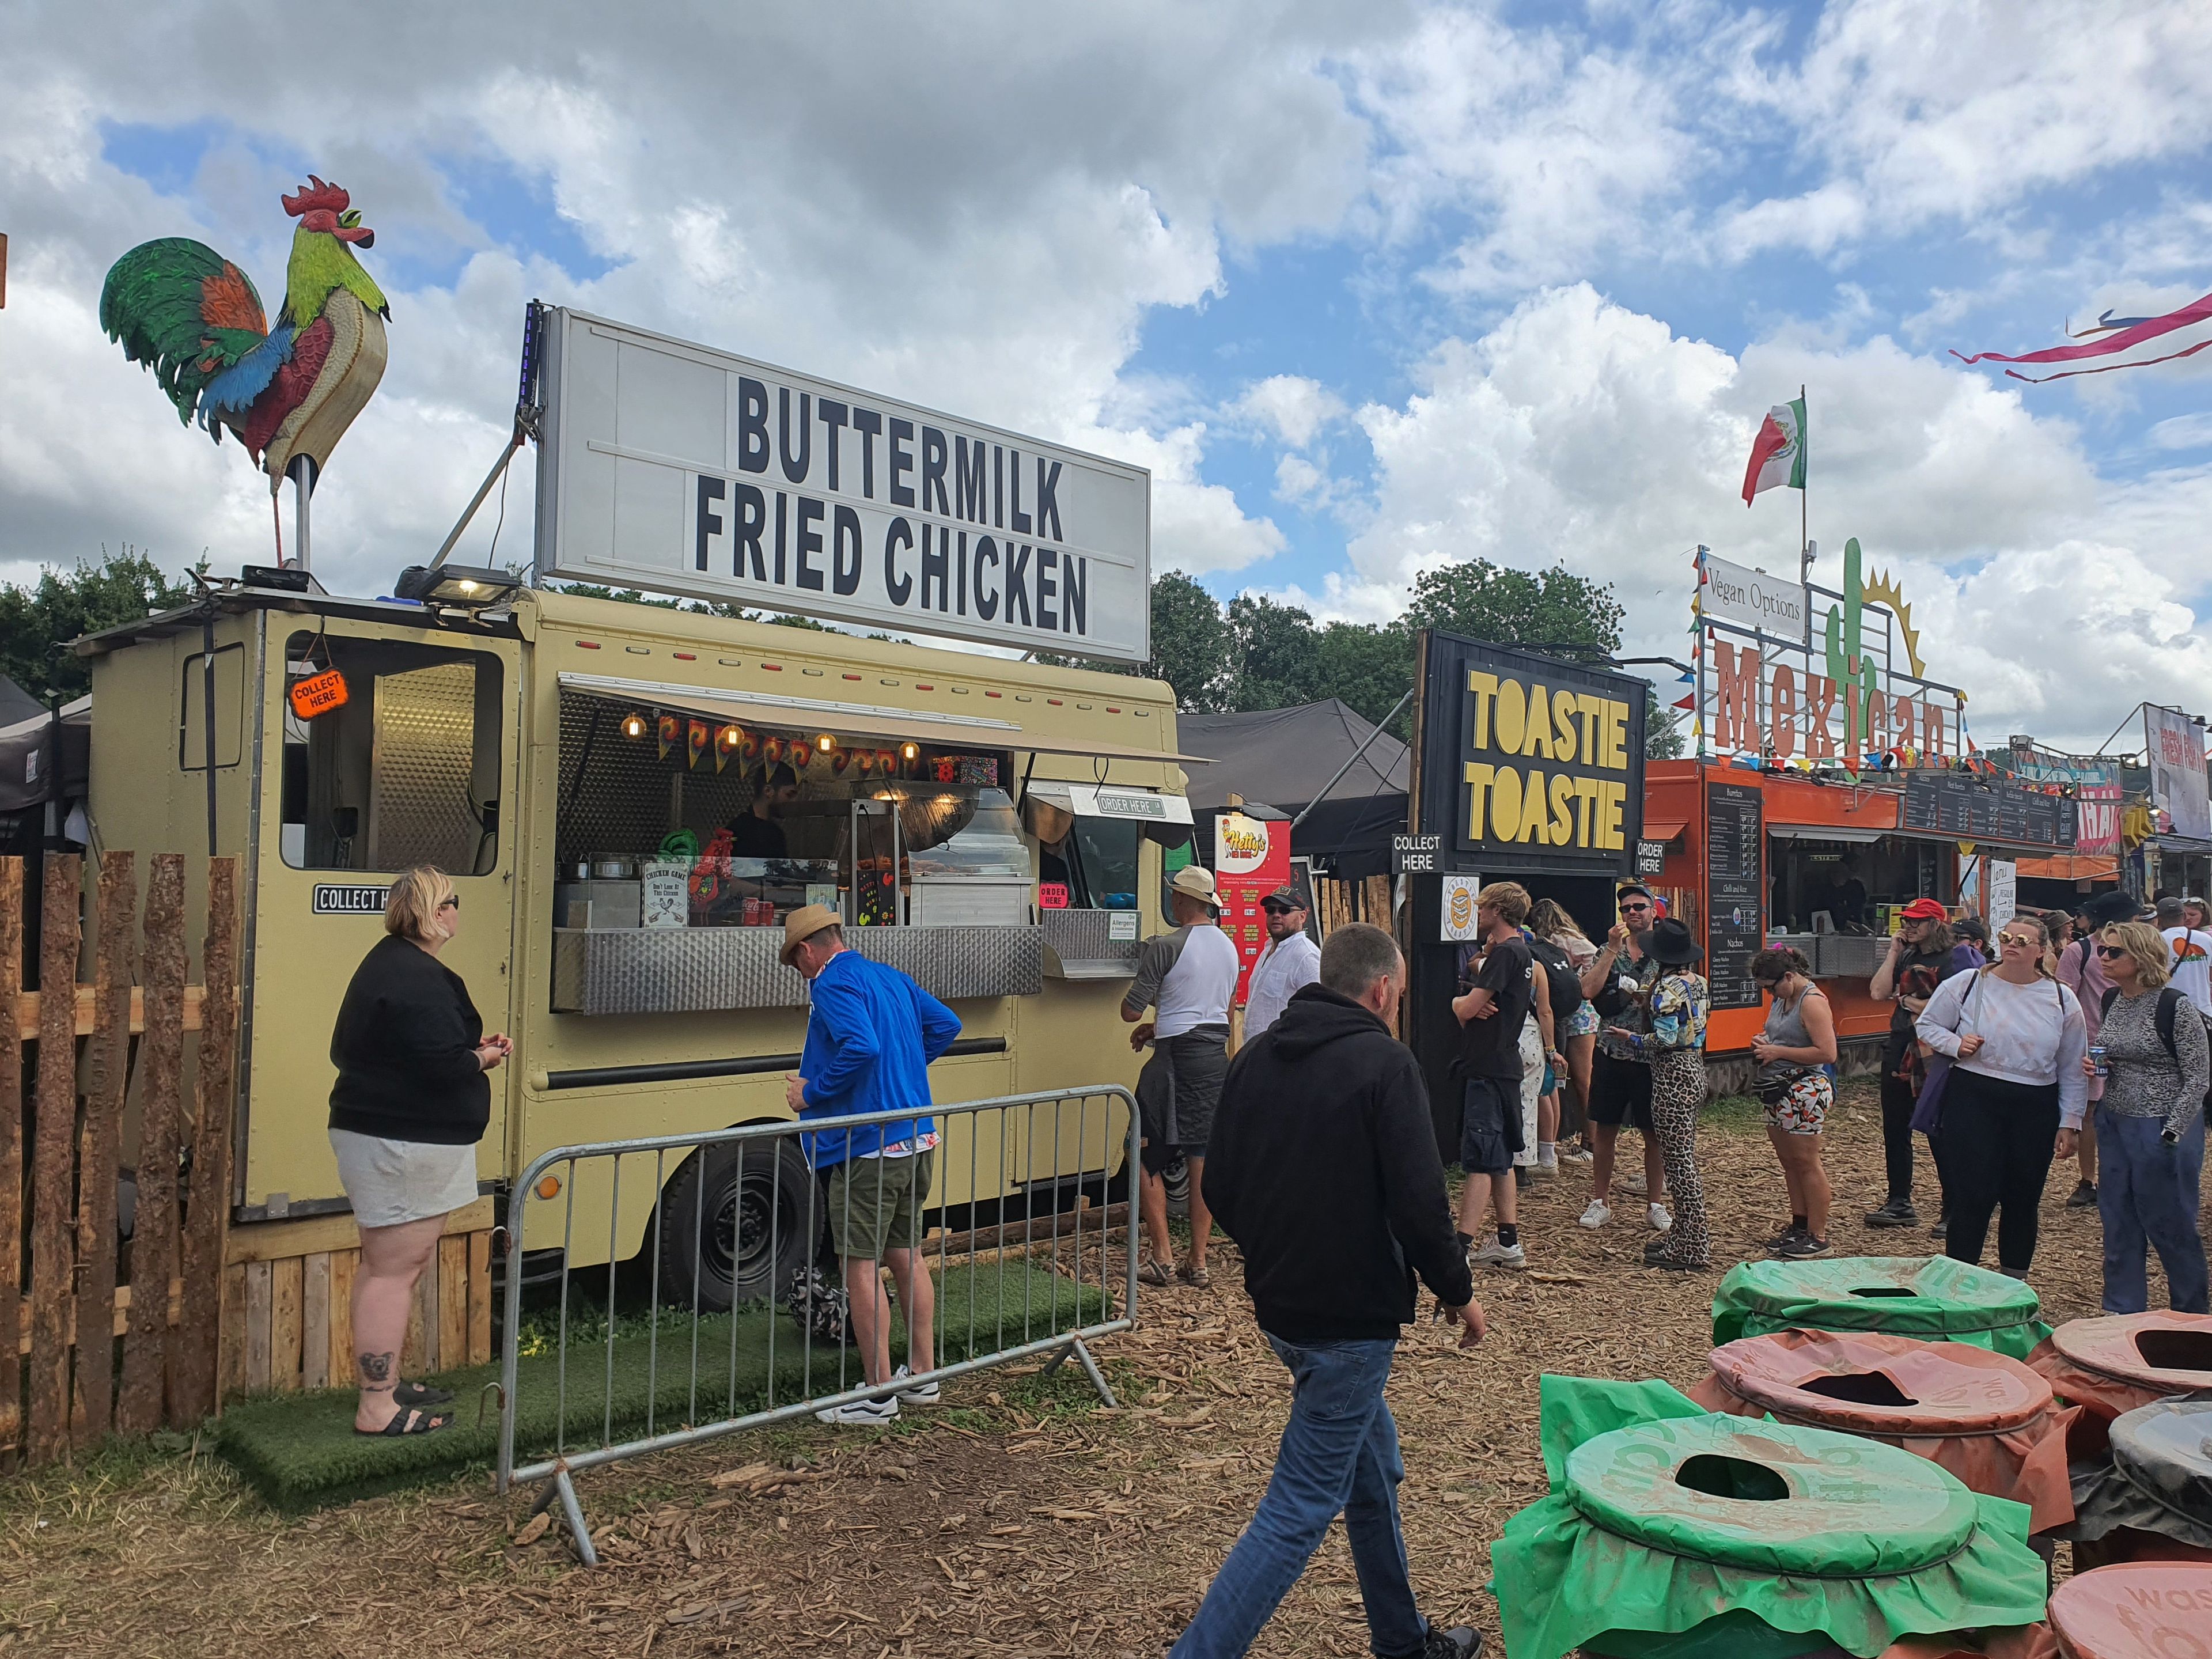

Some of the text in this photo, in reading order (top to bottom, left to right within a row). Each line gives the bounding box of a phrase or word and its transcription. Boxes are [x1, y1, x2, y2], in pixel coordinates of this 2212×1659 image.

[738, 377, 1063, 543] BUTTERMILK
[696, 475, 1086, 636] FRIED CHICKEN
[1707, 567, 1800, 620] Vegan Options
[295, 674, 339, 699] COLLECT
[309, 690, 337, 708] HERE
[1714, 638, 1944, 769] Mexican
[1467, 669, 1629, 770] TOASTIE
[1101, 797, 1129, 811] ORDER
[1129, 800, 1152, 813] HERE
[1464, 762, 1627, 851] TOASTIE
[1229, 830, 1266, 857] Hetty's
[1394, 836, 1440, 850] COLLECT
[1638, 842, 1663, 858] ORDER
[1402, 855, 1433, 870] HERE
[1639, 858, 1660, 872] HERE
[645, 870, 687, 881] CHICKEN GAME
[320, 889, 377, 909] COLLECT
[1041, 888, 1065, 896] ORDER
[1045, 896, 1061, 904] HERE
[1727, 937, 1744, 948] Nachos
